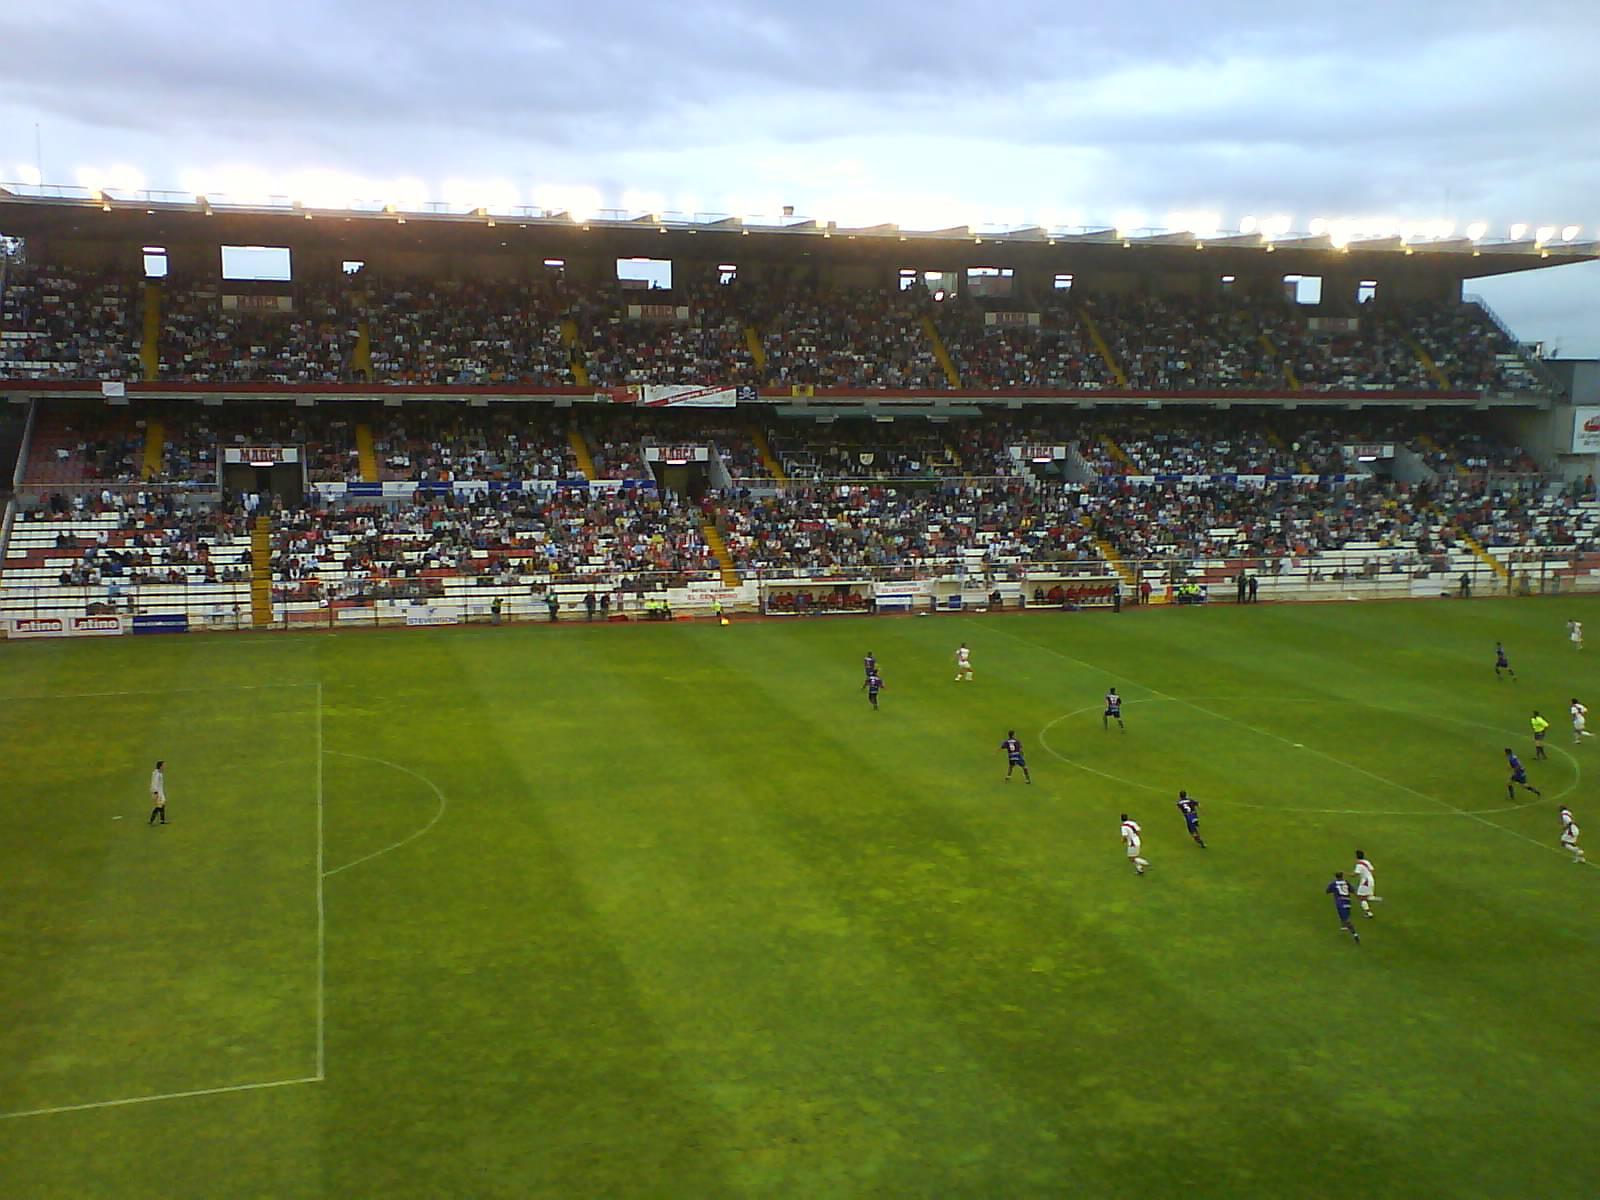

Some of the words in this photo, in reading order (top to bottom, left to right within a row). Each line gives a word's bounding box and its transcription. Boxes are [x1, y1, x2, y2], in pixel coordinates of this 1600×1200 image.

[658, 448, 696, 461] MARCA
[15, 619, 62, 632] Latino
[72, 617, 120, 631] Latino
